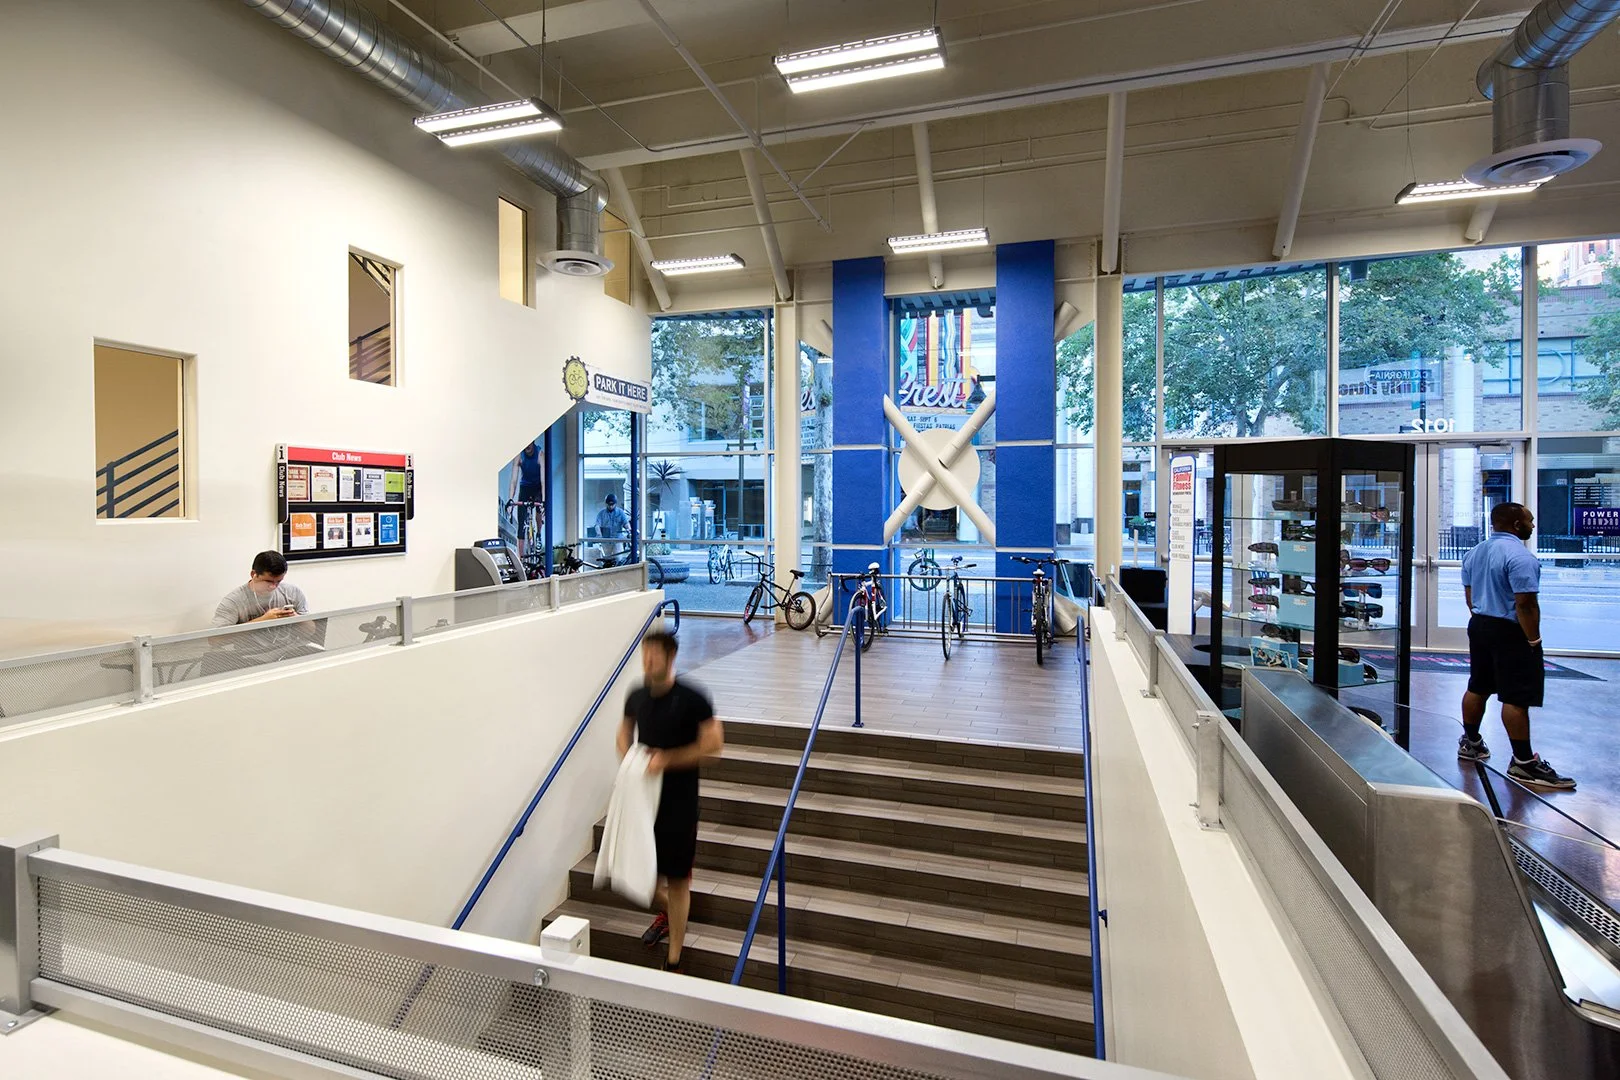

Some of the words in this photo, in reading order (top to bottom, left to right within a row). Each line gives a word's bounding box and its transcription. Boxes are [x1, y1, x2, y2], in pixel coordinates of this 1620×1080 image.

[596, 376, 617, 393] PARK
[618, 382, 626, 395] IT
[627, 384, 647, 400] HERE
[332, 452, 346, 460] Club
[346, 453, 362, 462] News
[1173, 472, 1191, 482] Family
[1173, 482, 1191, 490] Fitness
